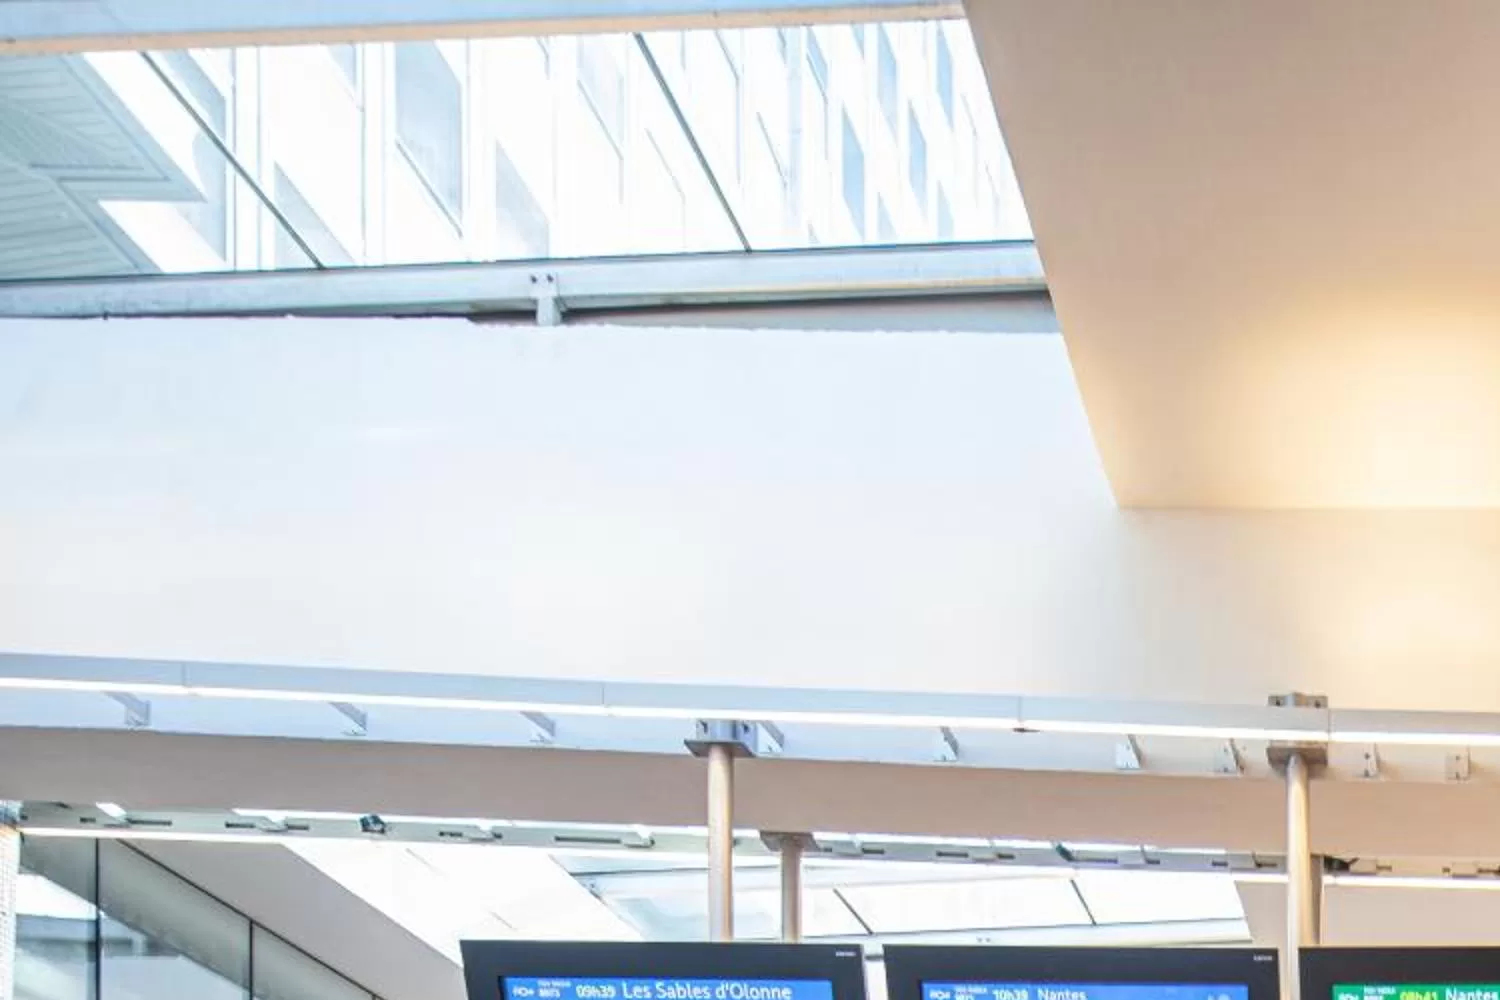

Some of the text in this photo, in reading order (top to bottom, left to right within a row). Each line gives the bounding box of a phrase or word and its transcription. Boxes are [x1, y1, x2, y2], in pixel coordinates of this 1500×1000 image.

[622, 982, 651, 999] Les
[655, 981, 711, 1000] Sables
[715, 981, 793, 1000] d'Olonne
